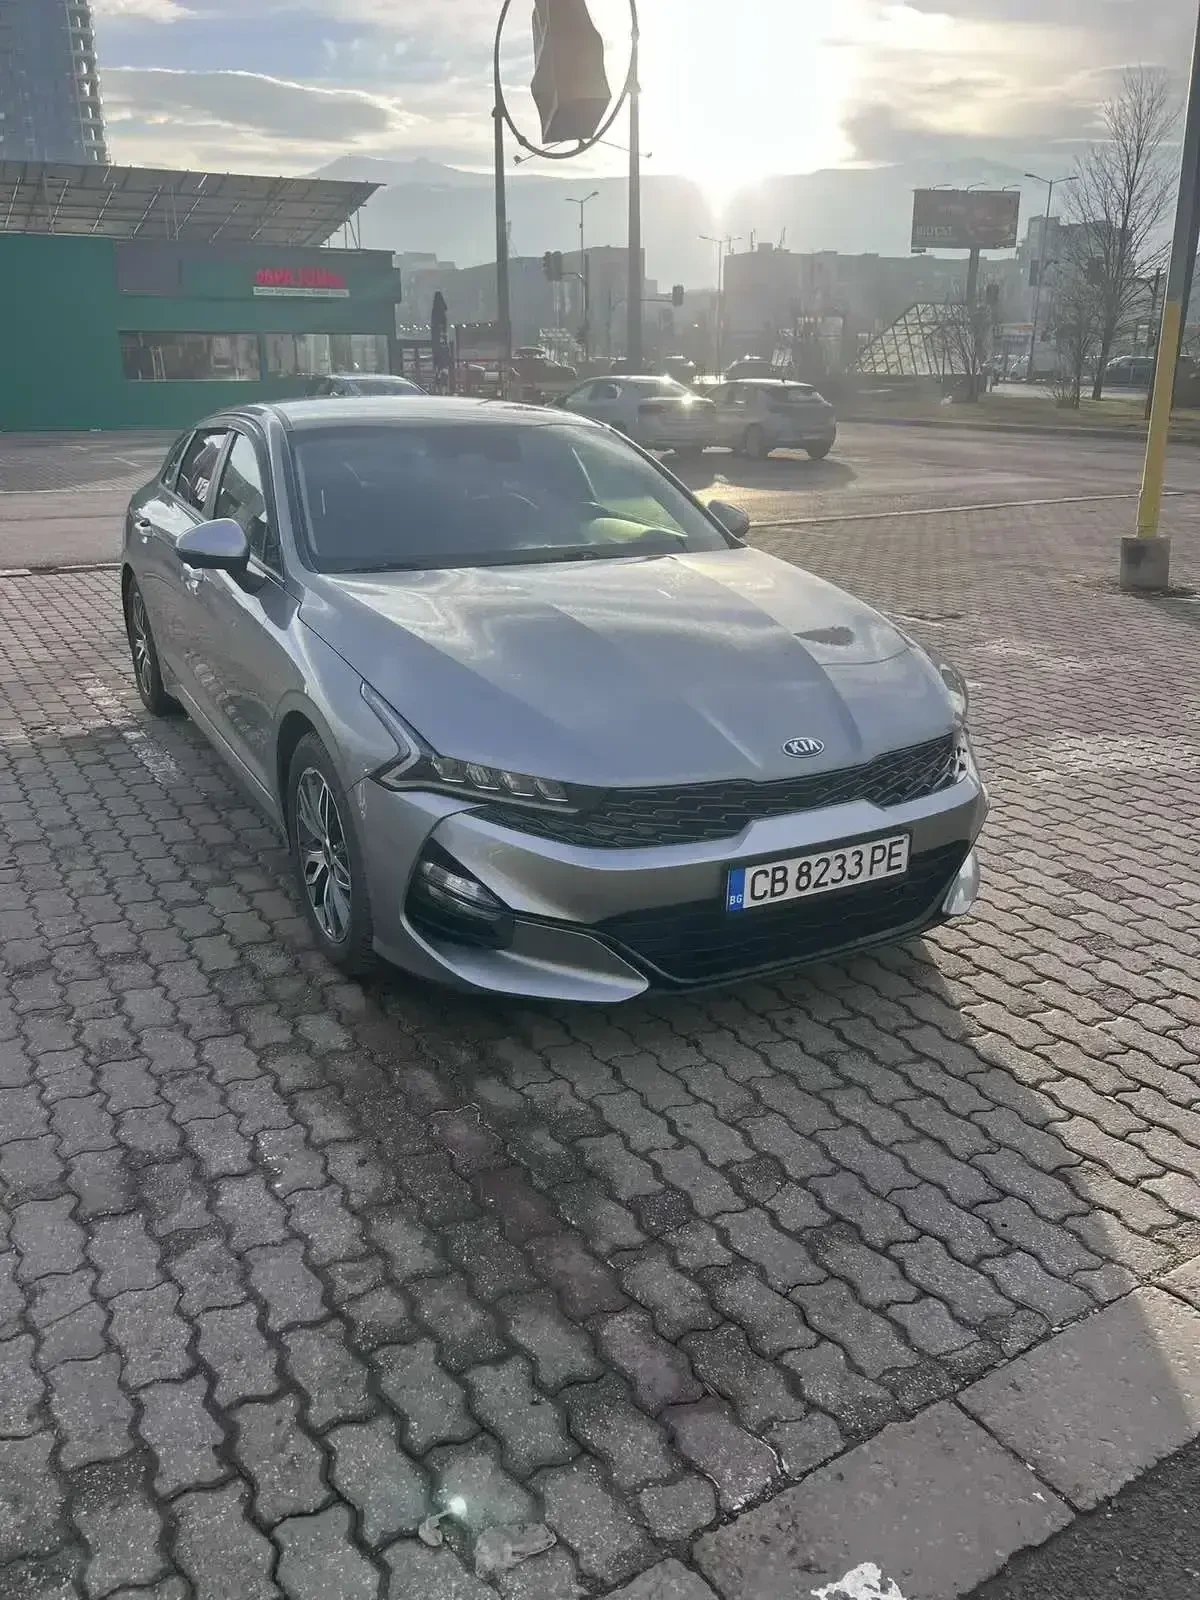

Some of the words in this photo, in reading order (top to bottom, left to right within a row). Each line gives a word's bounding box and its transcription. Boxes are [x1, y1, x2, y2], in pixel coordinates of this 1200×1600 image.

[788, 738, 820, 754] KIA
[750, 865, 788, 900] CB
[795, 850, 864, 892] 8233
[868, 839, 904, 876] PE
[730, 894, 743, 905] BG
